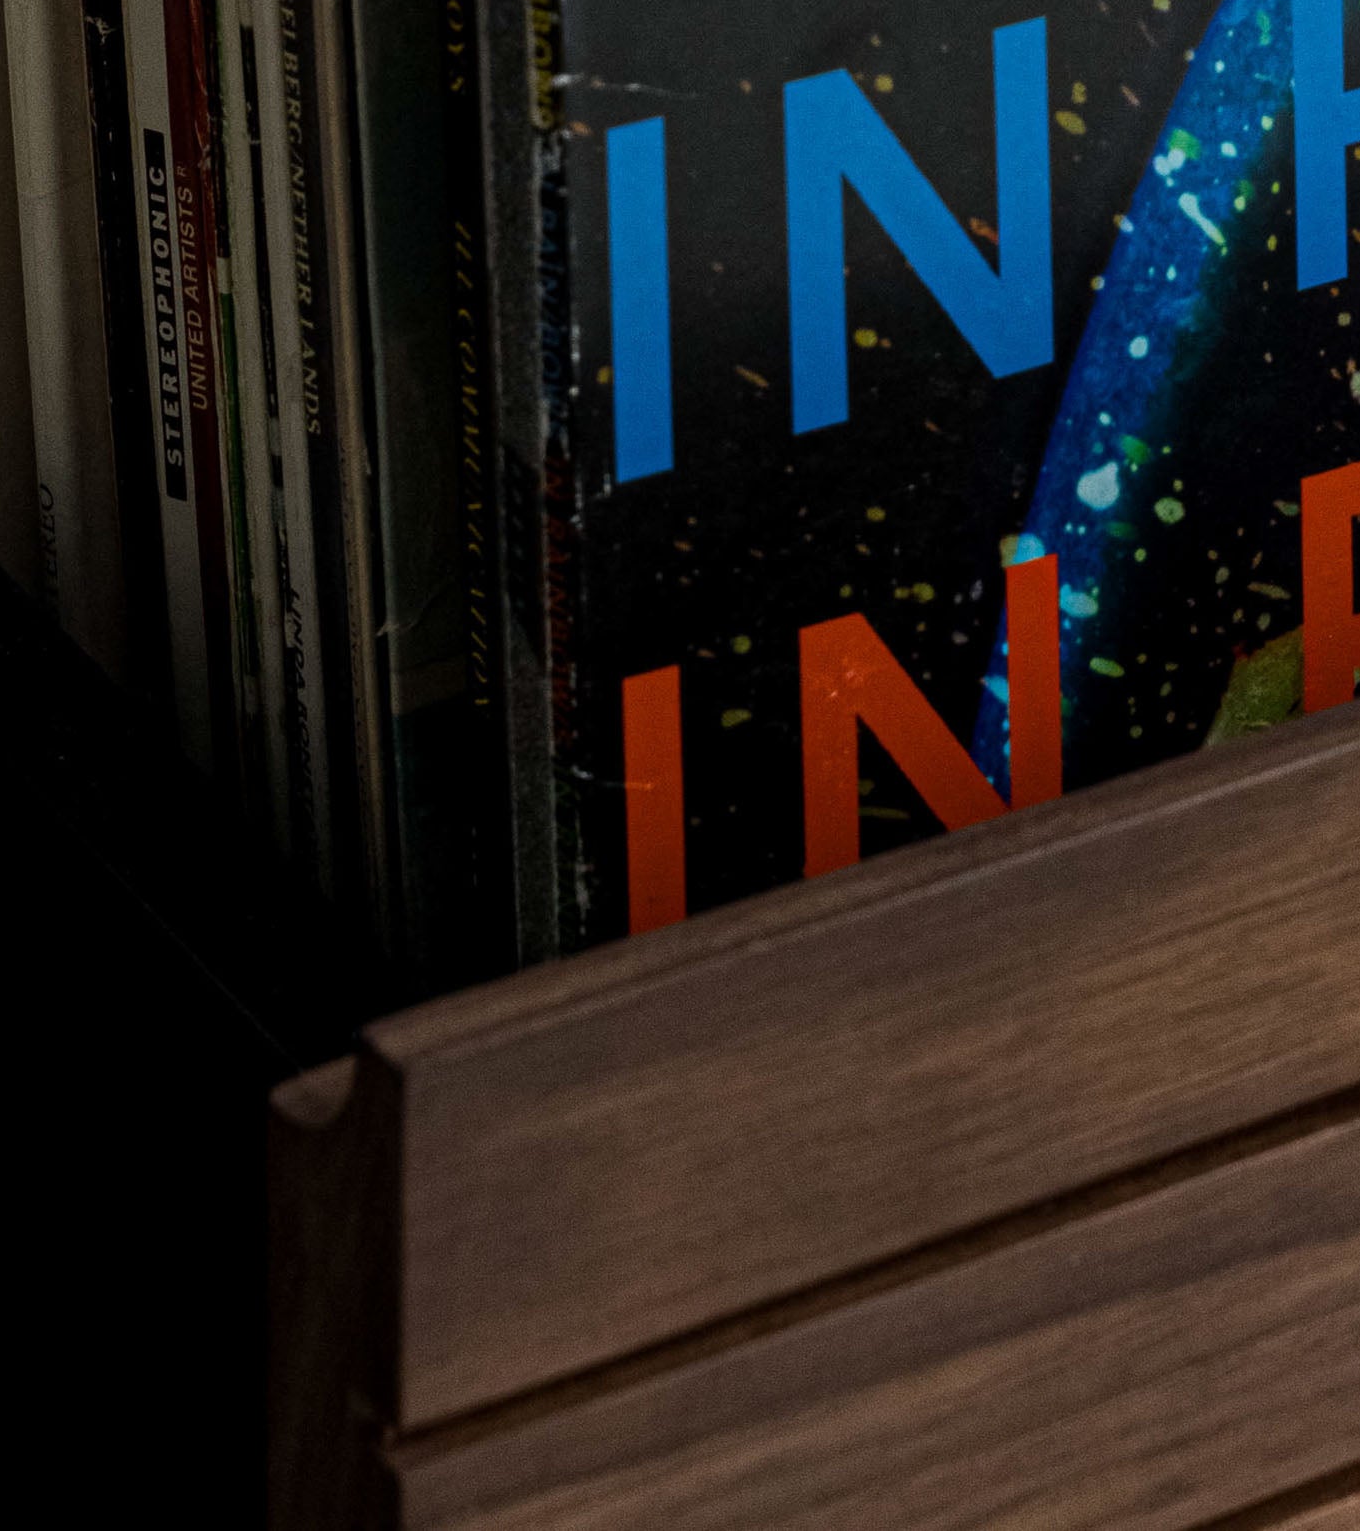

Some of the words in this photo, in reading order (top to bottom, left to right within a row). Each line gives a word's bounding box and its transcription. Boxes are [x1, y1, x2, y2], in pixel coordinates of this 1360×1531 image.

[146, 165, 183, 467] STEREOPHONIC
[176, 186, 203, 296] ARTISTS
[182, 303, 208, 410] UNITED
[603, 16, 1055, 484] IN
[620, 551, 1065, 936] IN
